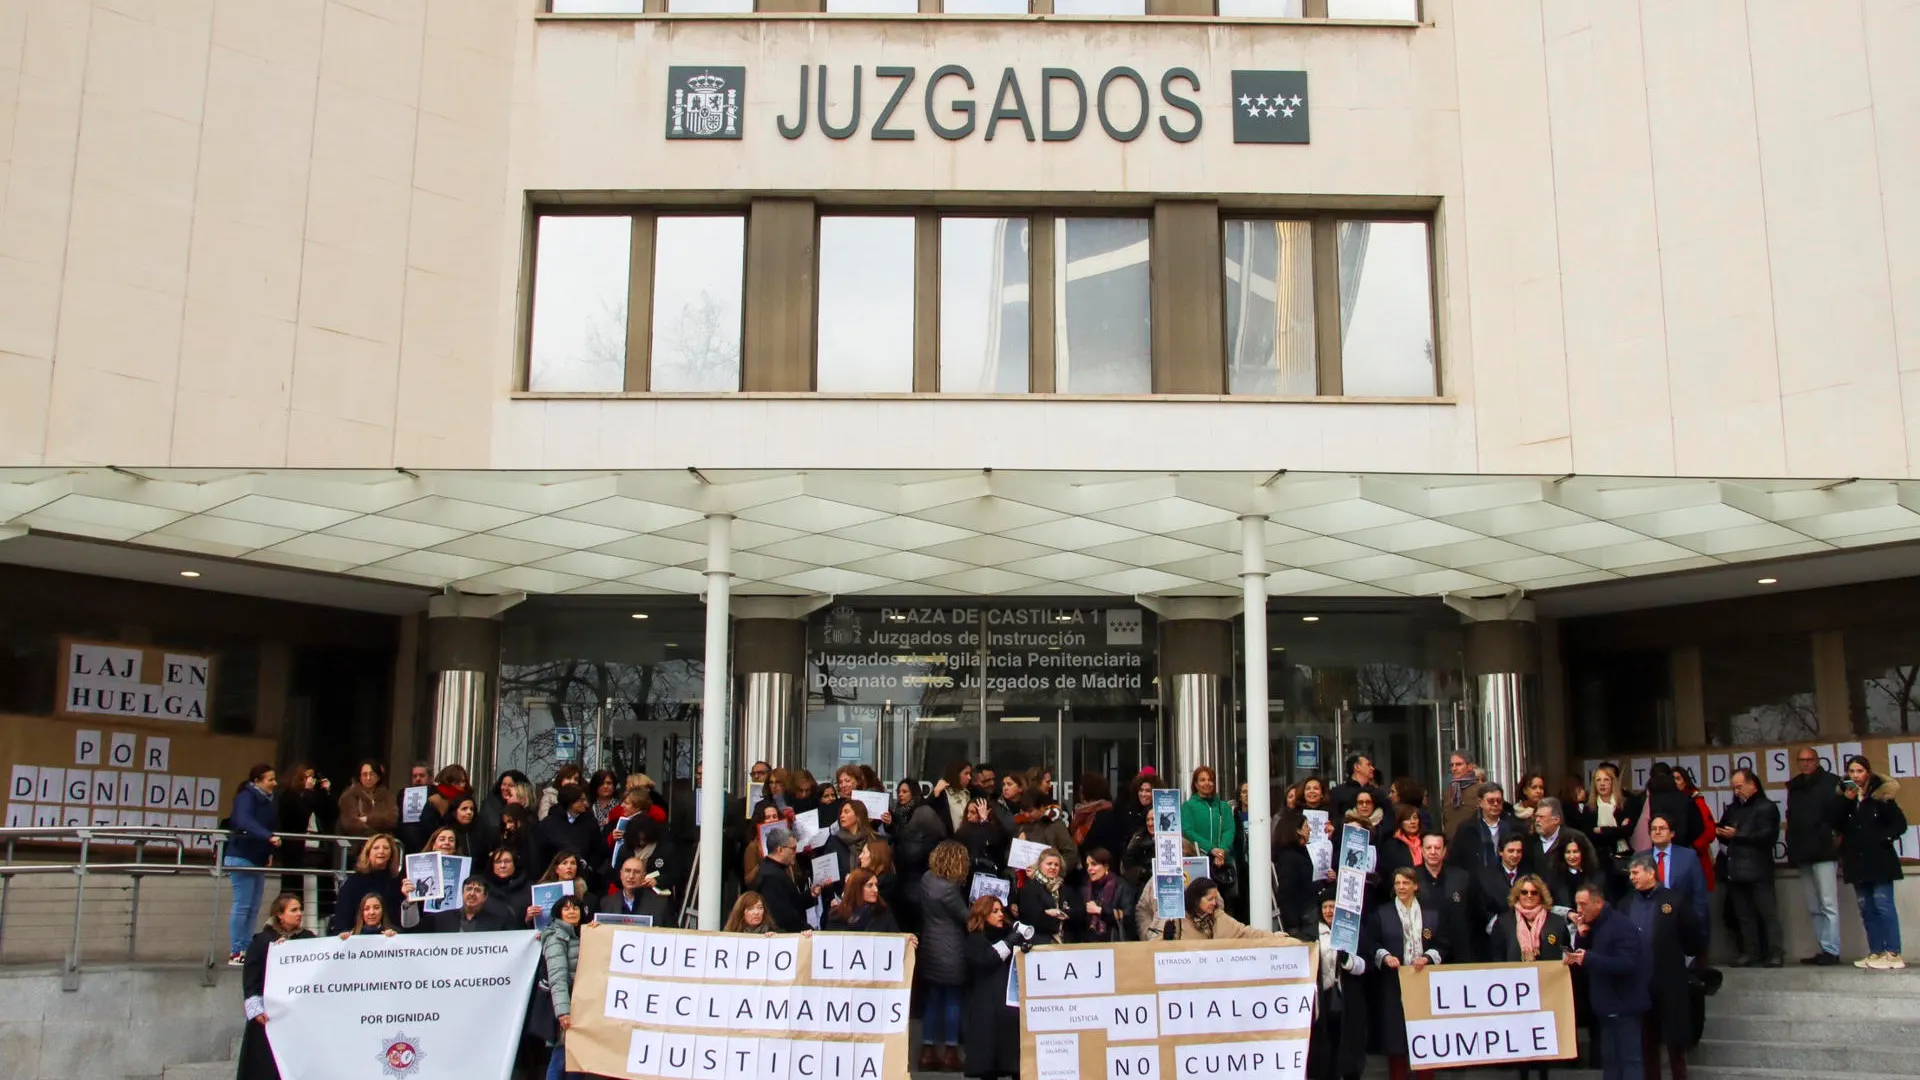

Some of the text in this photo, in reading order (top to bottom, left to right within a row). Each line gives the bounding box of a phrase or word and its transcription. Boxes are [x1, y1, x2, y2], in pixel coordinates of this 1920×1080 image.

[775, 64, 1202, 143] JUZGADOS
[881, 608, 1099, 625] PLAZA DE CASTILLA 1
[868, 630, 1085, 649] Juzgados de Instrucción
[74, 654, 208, 686] LAJ EN
[815, 652, 1141, 670] Juzgados de Vigilancia Penitenciaria
[815, 673, 1141, 692] Decanato de los Juzgados de Madrid
[72, 687, 206, 719] HUELGA
[80, 741, 163, 767] POR
[15, 777, 216, 808] DIGNIDAD
[279, 945, 509, 965] LETRADOS de la ADMINISTRACIÓN DE JUSTICIA
[619, 943, 893, 972] CUERPO LAJ
[1158, 957, 1193, 966] LETRADOS
[1037, 961, 1102, 982] LAJ
[1270, 963, 1298, 972] JUSTICIA
[288, 976, 511, 995] POR EL CUMPLIMIENTO DE LOS ACUERDOS
[1436, 982, 1530, 1010] LLOP
[360, 1012, 440, 1024] POR DIGNIDAD
[614, 989, 902, 1024] RECLAMAMOS
[1030, 1004, 1078, 1013] MINISTRA DE
[1114, 995, 1311, 1025] NO DIALOGA
[1069, 1014, 1099, 1023] JUSTICIA
[1411, 1026, 1548, 1060] CUMPLE
[638, 1043, 879, 1079] JUSTICIA
[1116, 1051, 1303, 1077] NO CUMPLE
